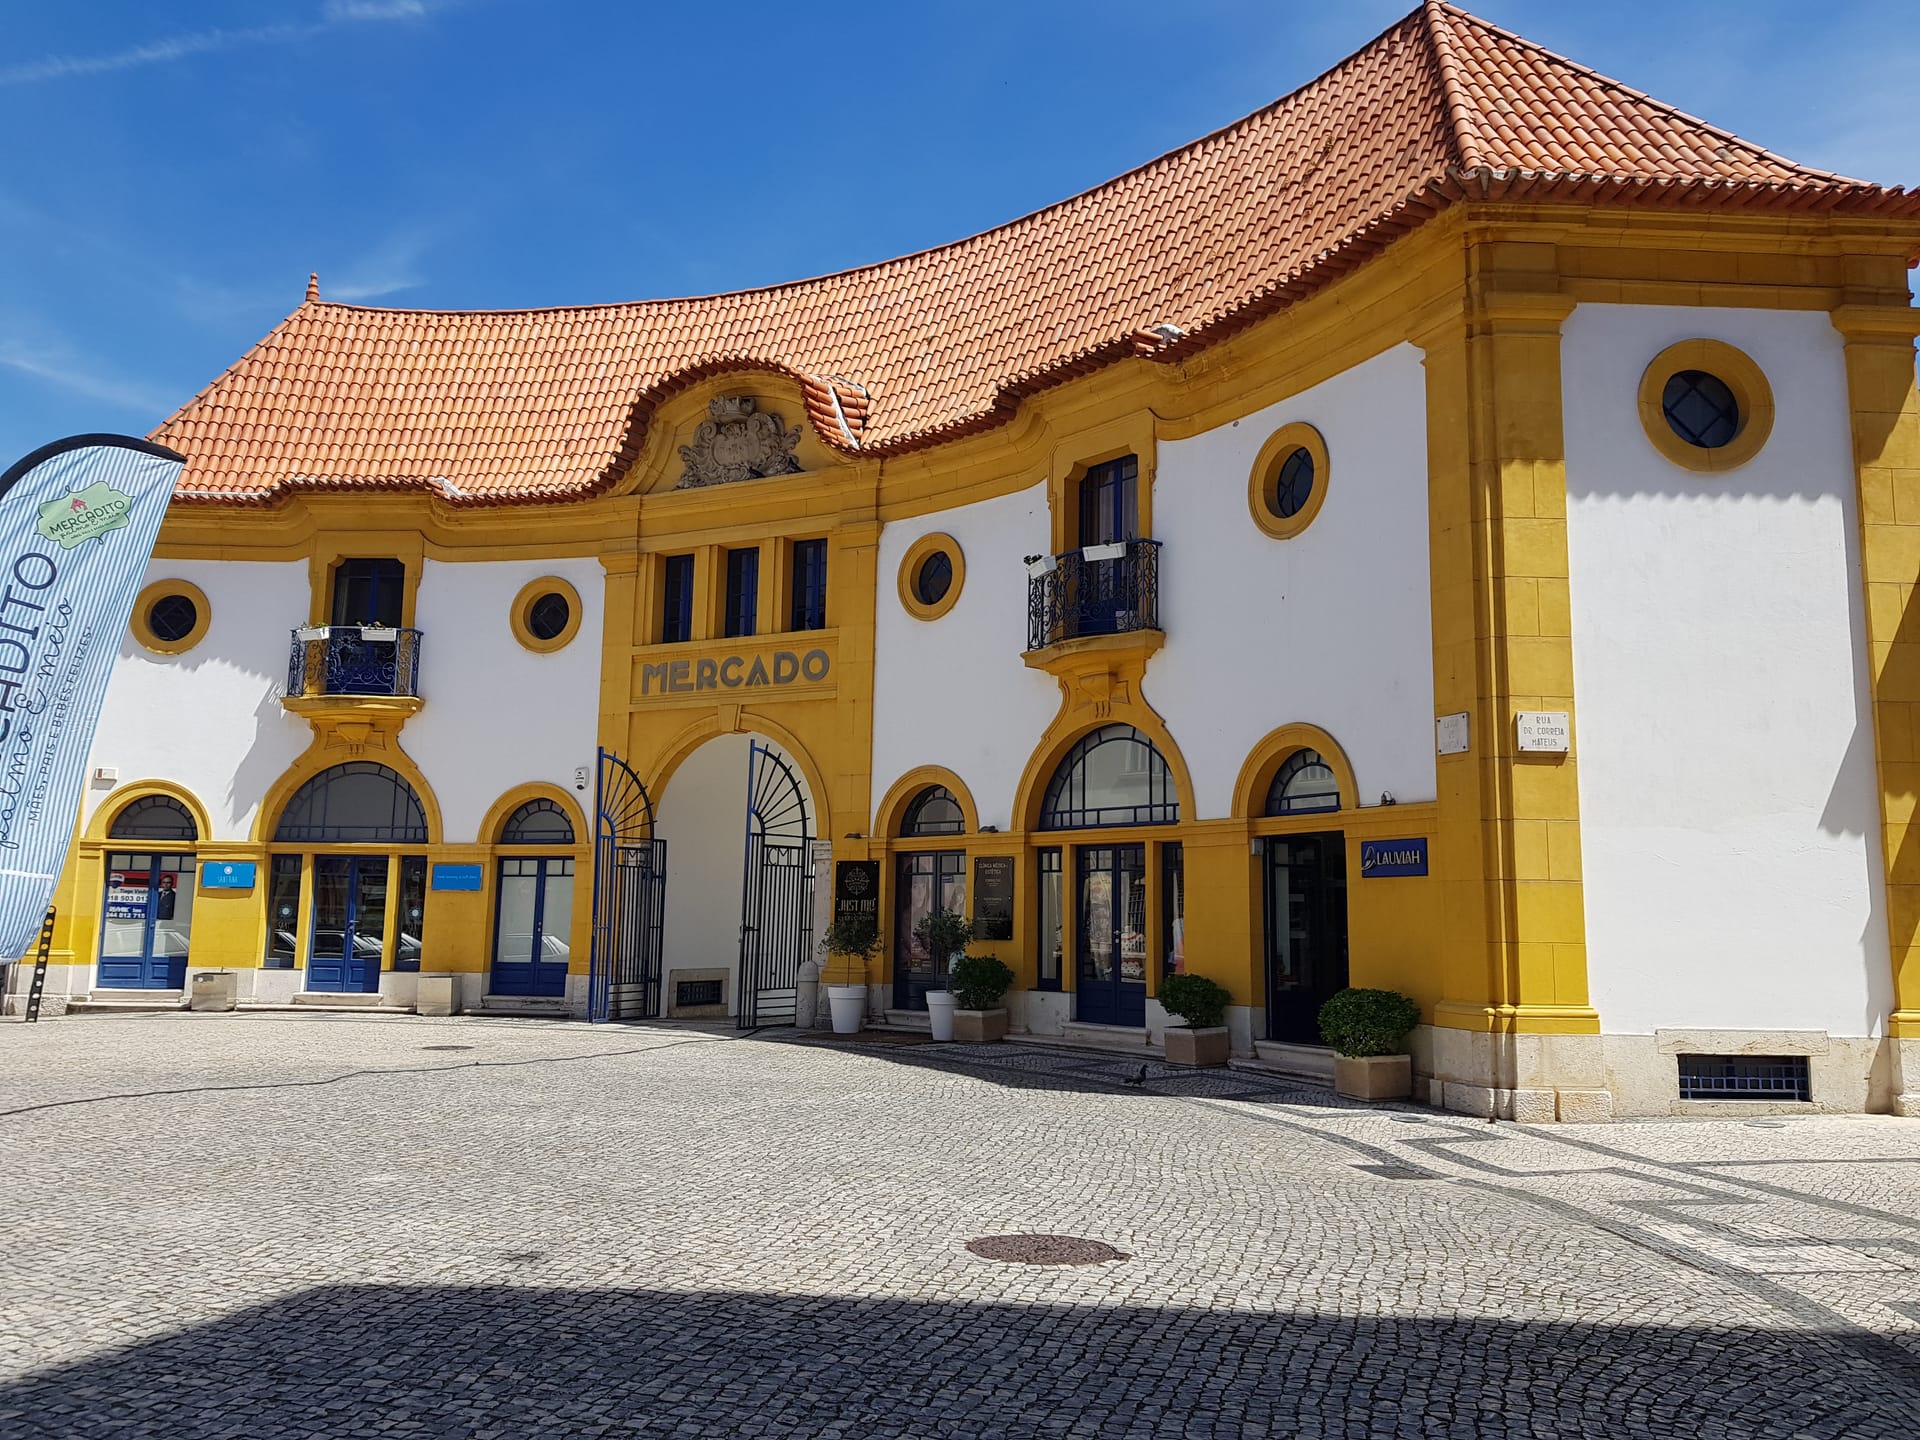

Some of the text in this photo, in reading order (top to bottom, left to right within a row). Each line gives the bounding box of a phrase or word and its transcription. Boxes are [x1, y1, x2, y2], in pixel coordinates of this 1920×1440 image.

[49, 500, 125, 535] MERCADITO
[37, 597, 72, 680] meio
[642, 648, 830, 695] MERCADO
[40, 743, 56, 775] PAIS
[49, 731, 59, 739] E
[66, 631, 91, 684] FELIZES
[1536, 715, 1551, 724] RUA
[1537, 726, 1564, 736] CORREIA
[1531, 737, 1557, 746] MATEUS
[1376, 849, 1420, 866] LAUVIAH
